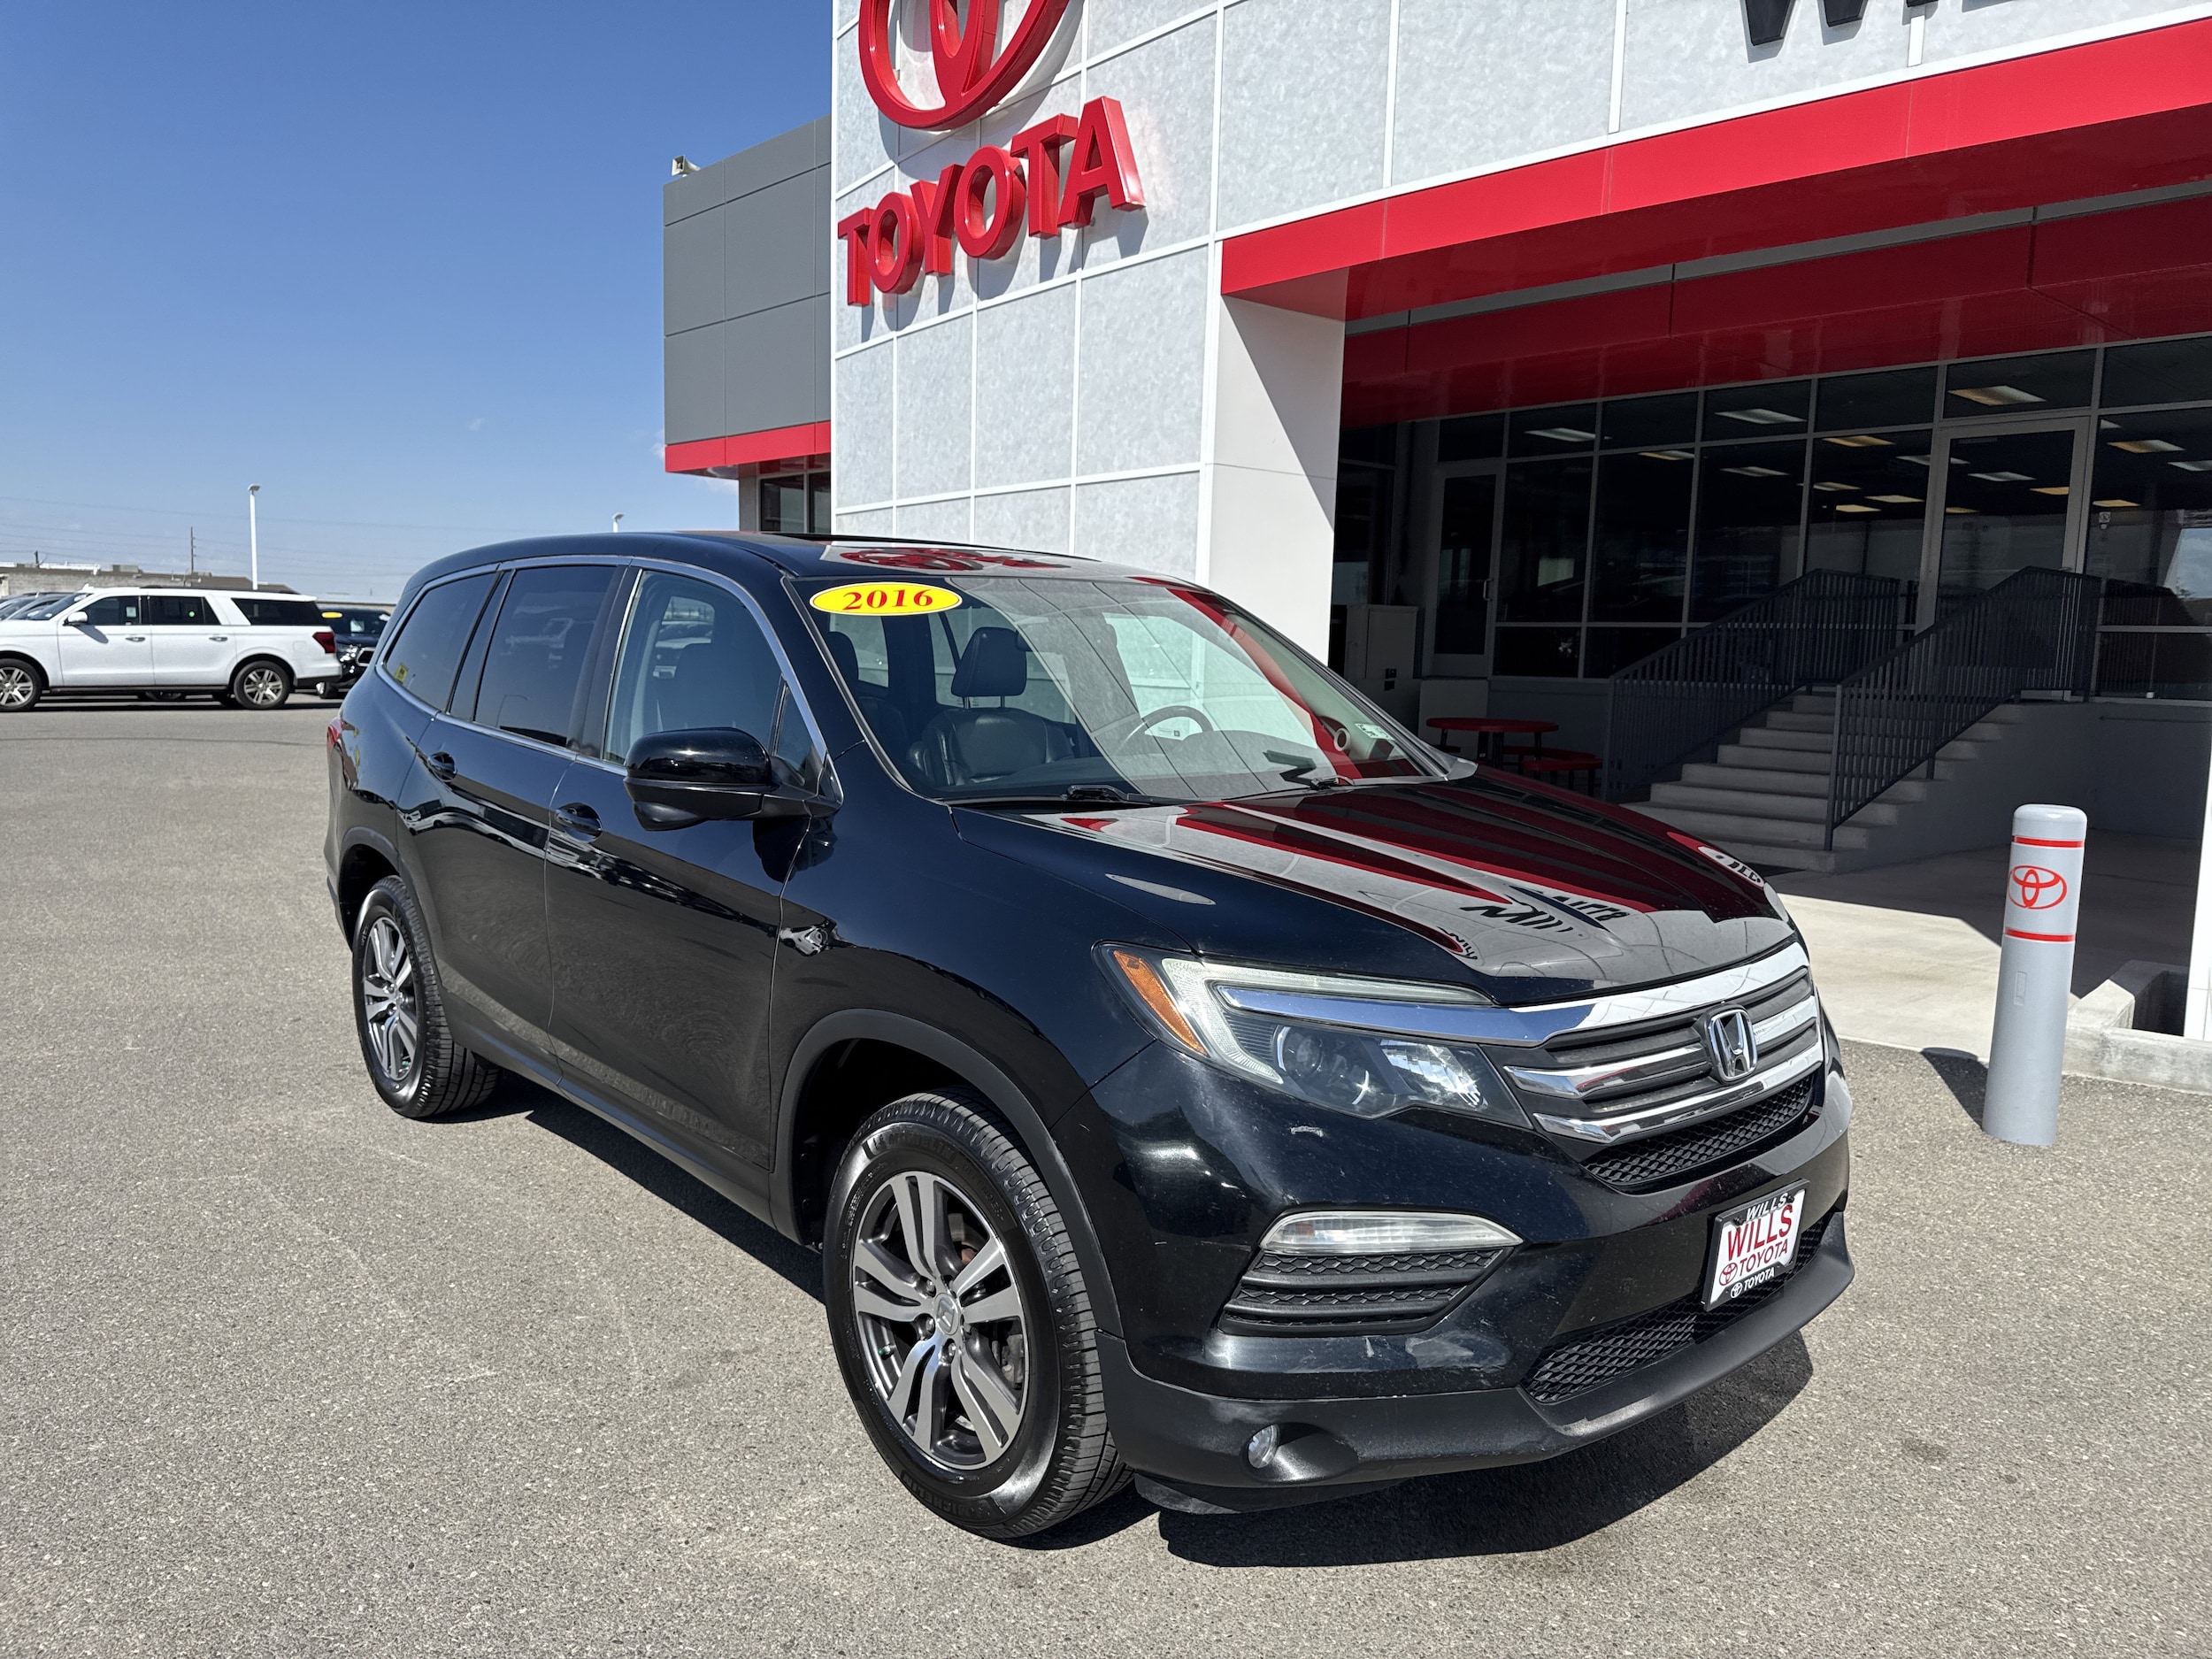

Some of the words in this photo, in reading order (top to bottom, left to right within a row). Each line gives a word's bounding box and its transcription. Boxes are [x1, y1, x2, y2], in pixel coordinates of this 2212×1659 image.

[838, 96, 1146, 306] TOYOTA
[842, 588, 933, 611] 2016
[1746, 1192, 1788, 1221] WILLS
[1728, 1205, 1793, 1261] WILLS
[1740, 1239, 1788, 1277] TOYOTA
[1744, 1267, 1775, 1291] TOYOTA
